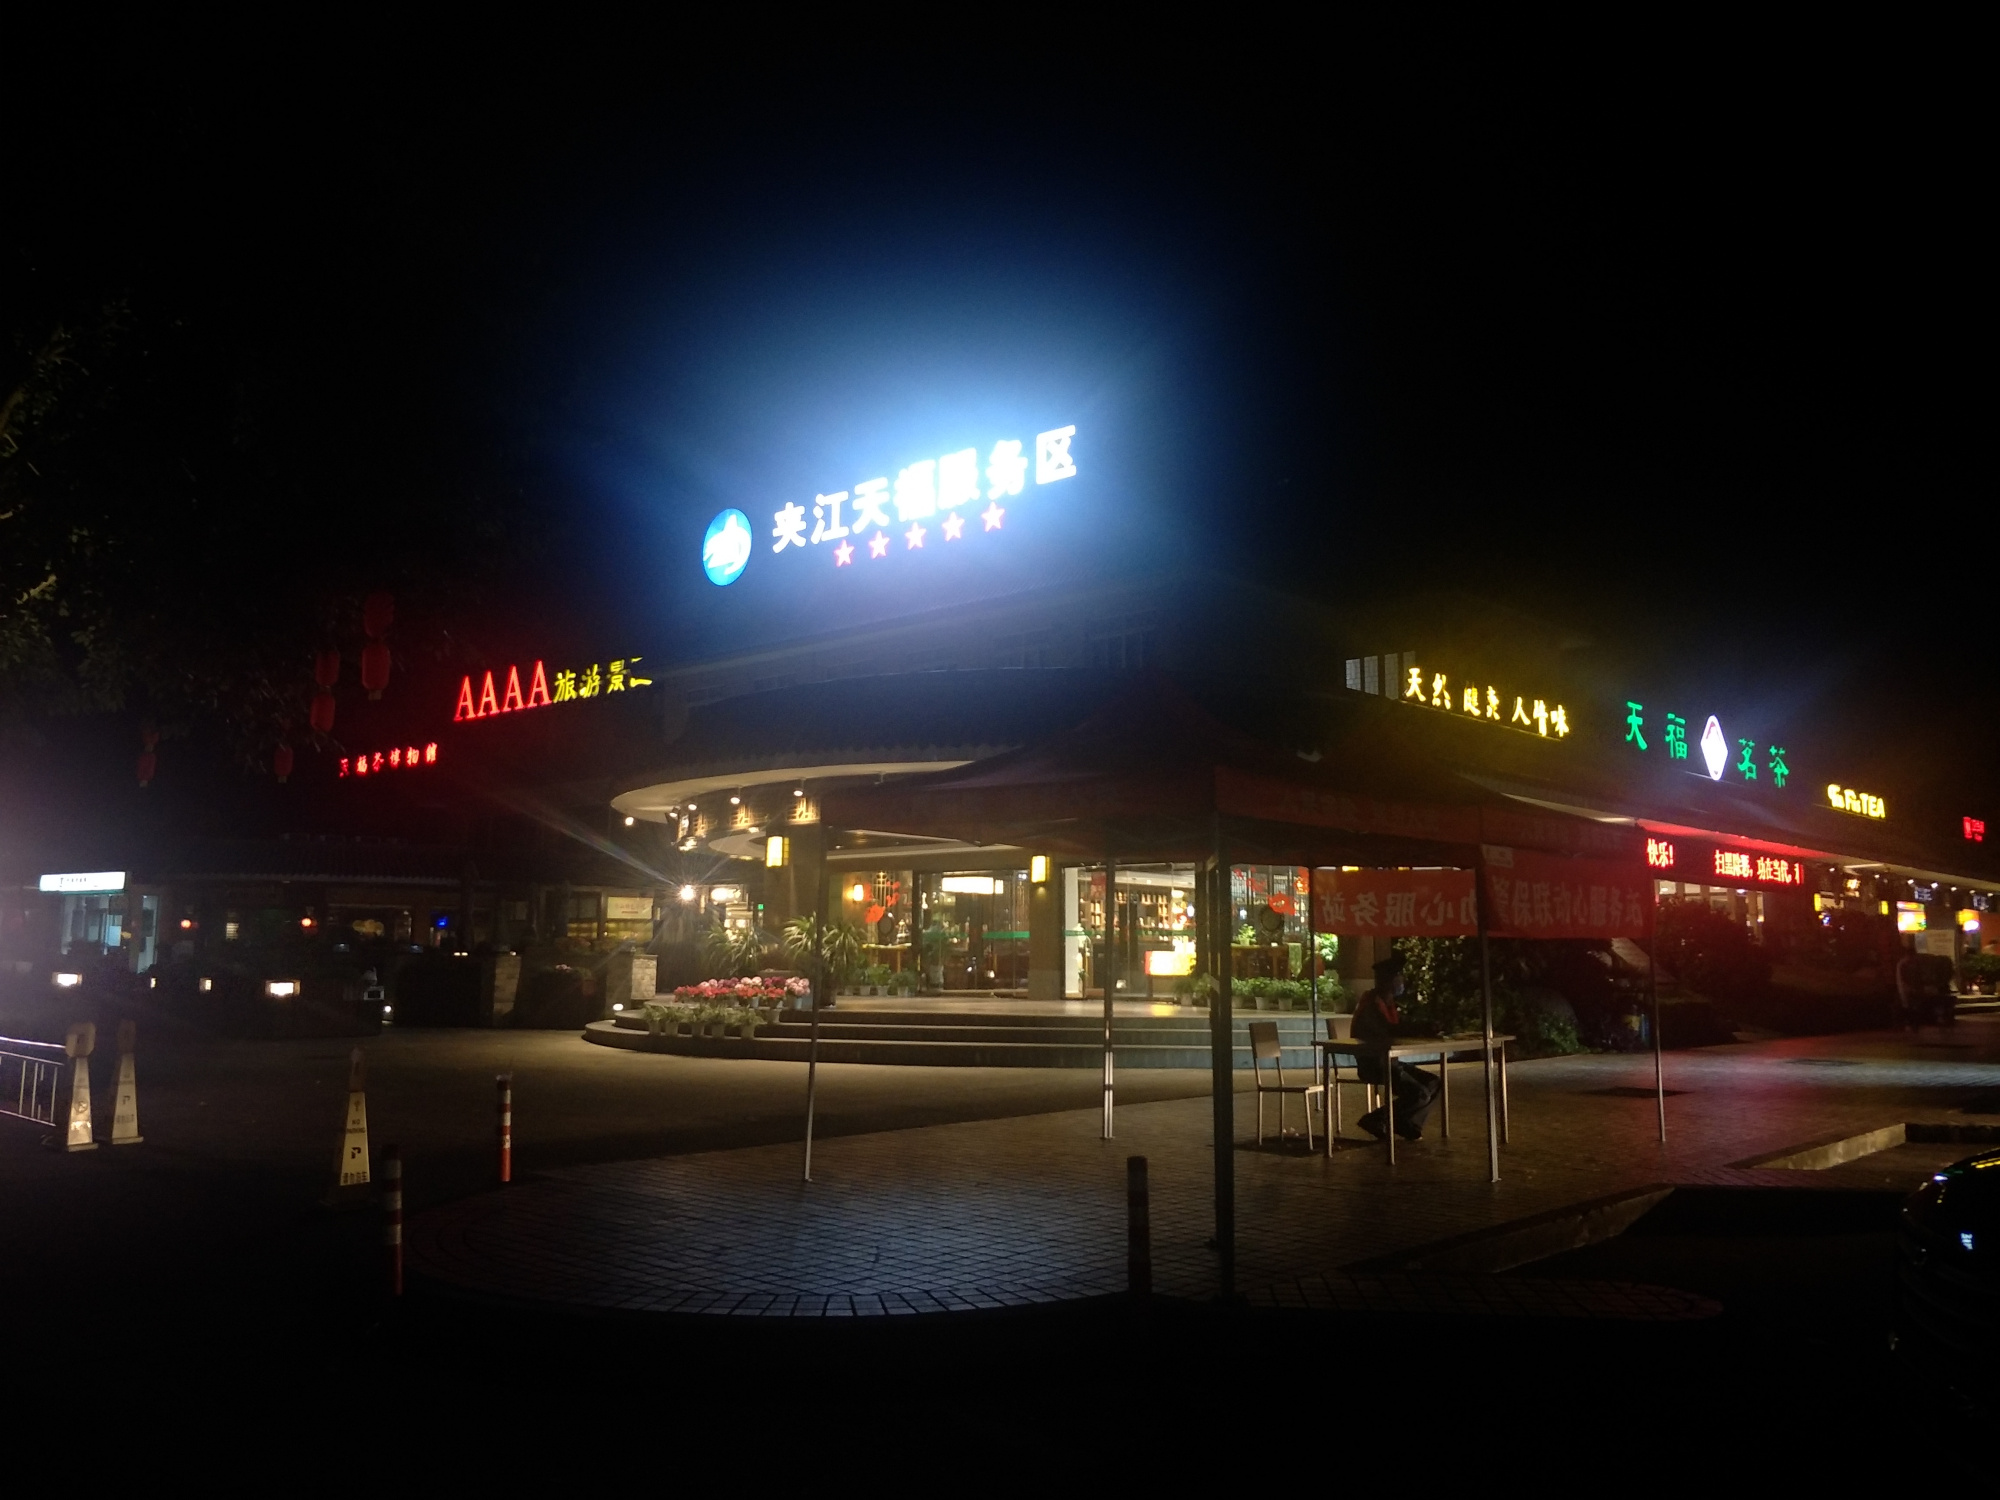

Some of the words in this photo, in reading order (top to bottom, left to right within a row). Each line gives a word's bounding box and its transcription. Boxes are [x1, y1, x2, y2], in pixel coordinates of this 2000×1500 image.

[772, 424, 1077, 554] 夹江天福服务区
